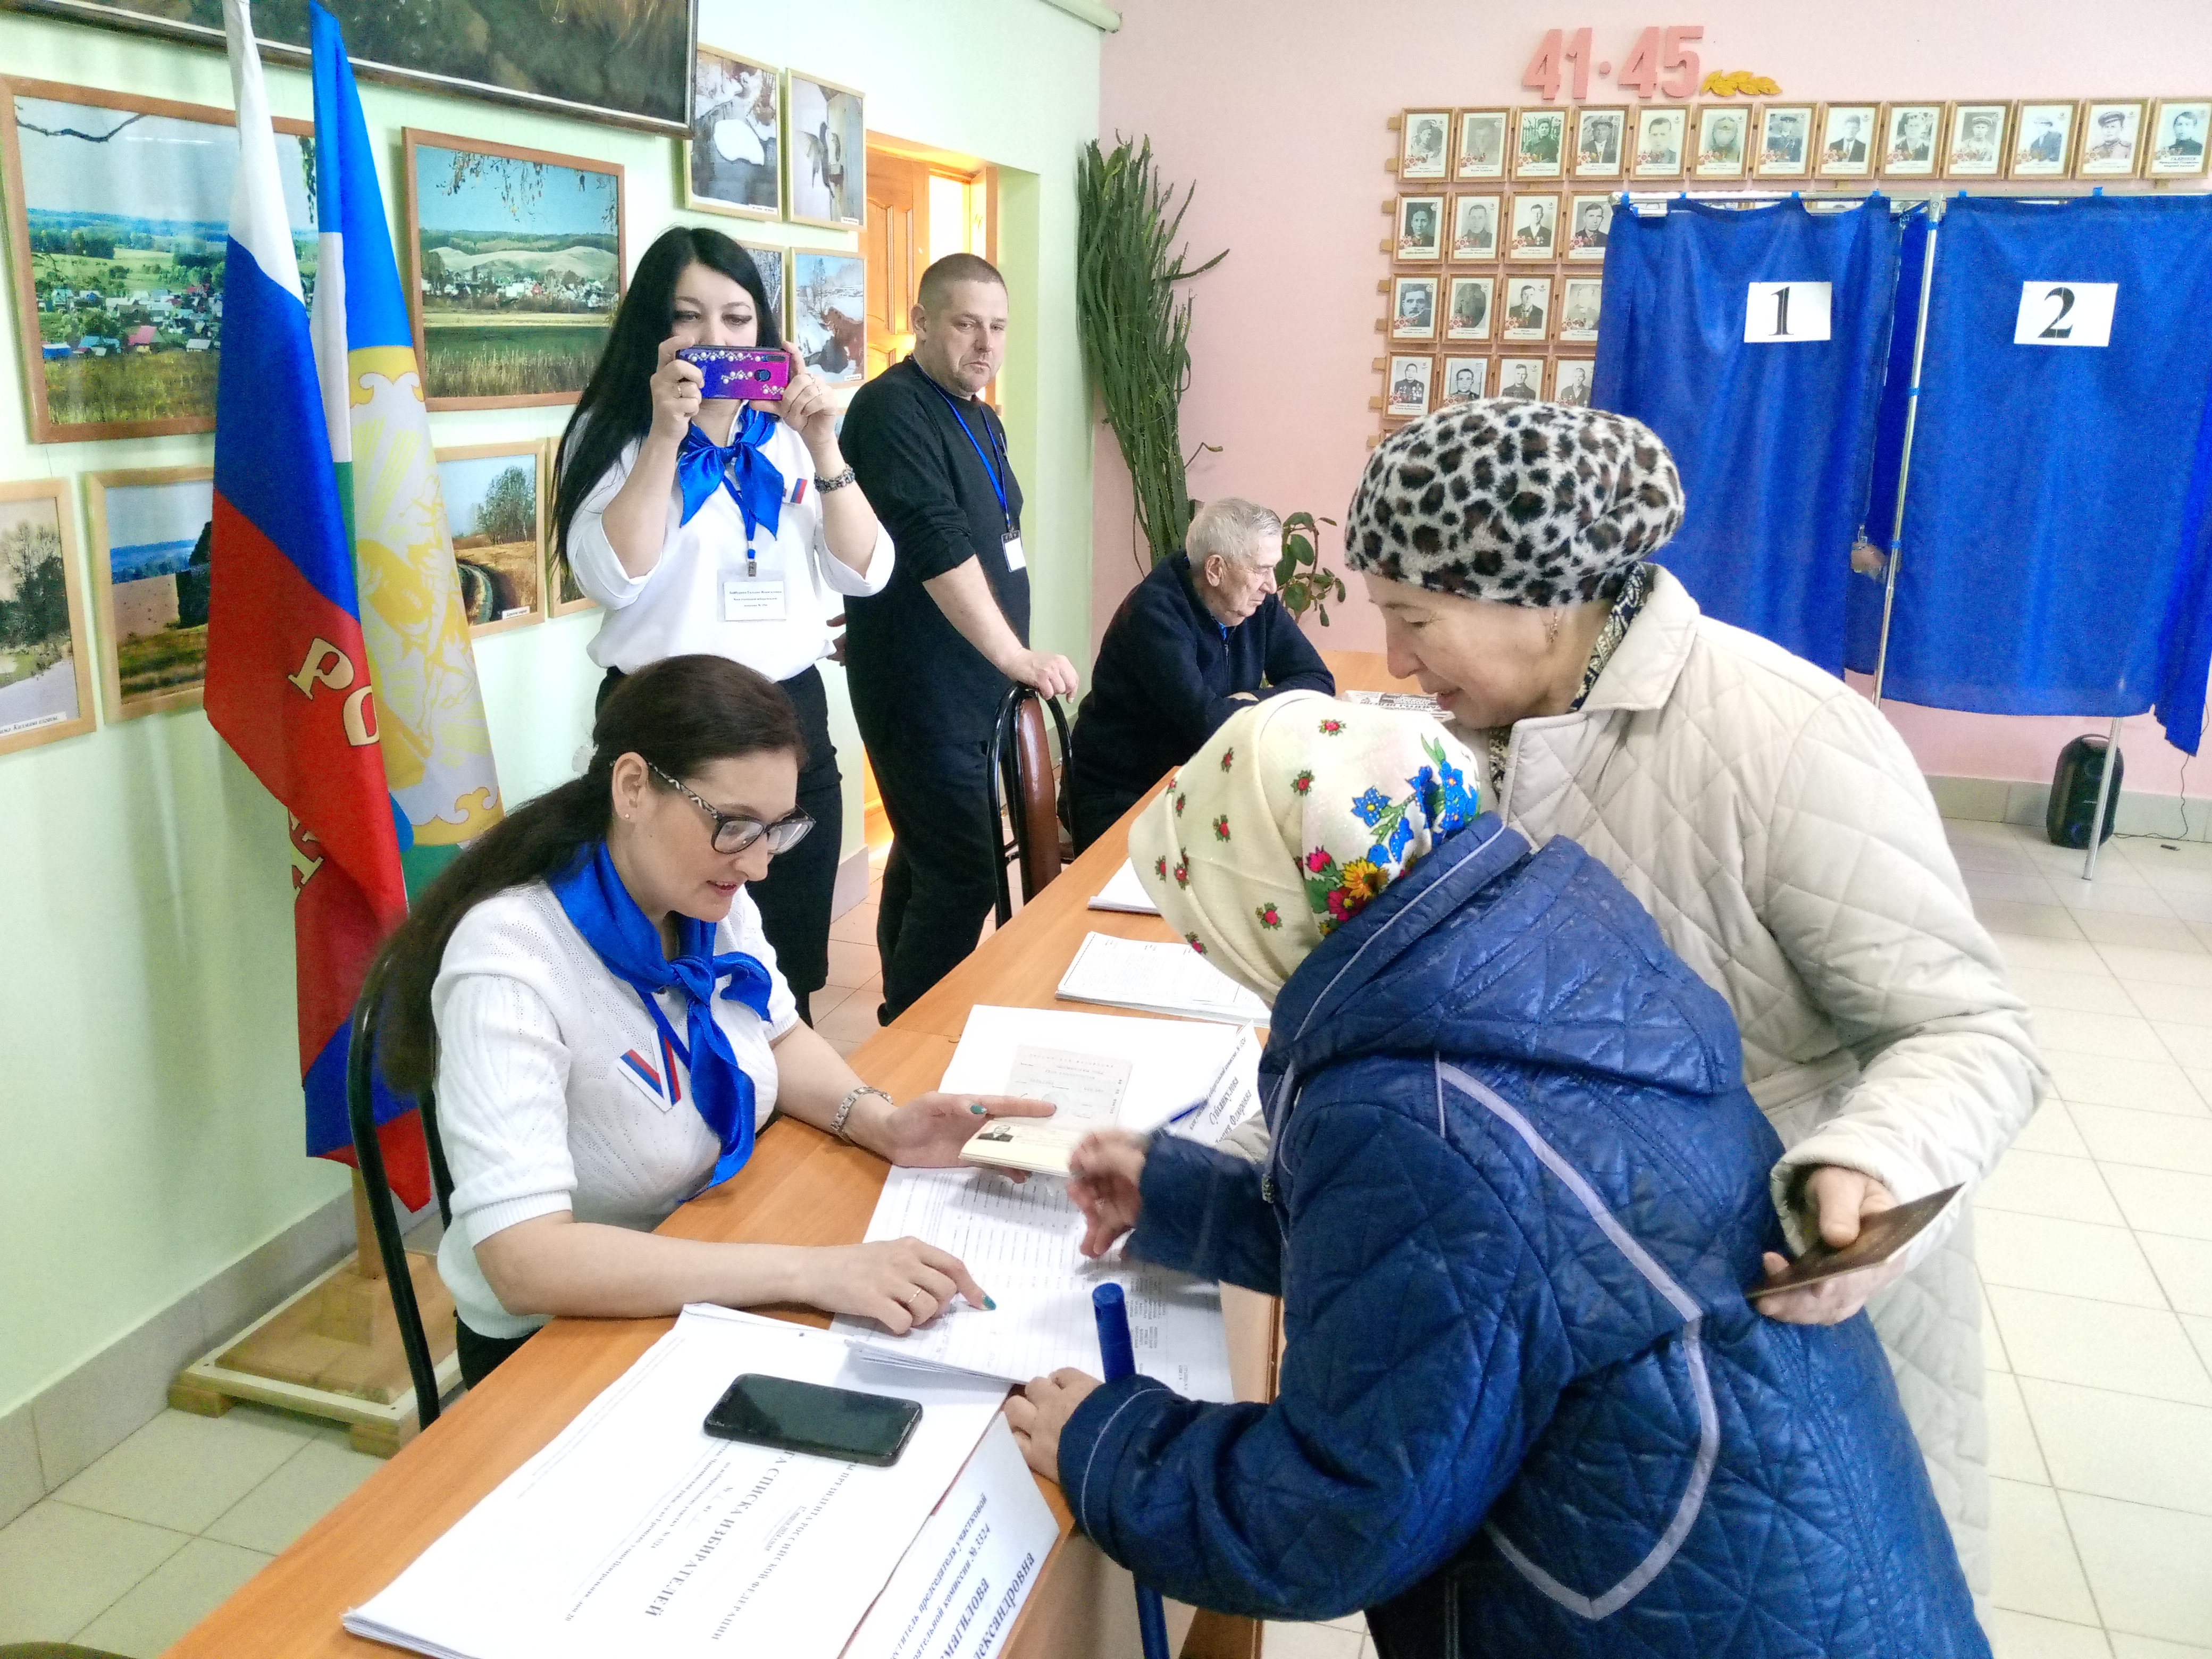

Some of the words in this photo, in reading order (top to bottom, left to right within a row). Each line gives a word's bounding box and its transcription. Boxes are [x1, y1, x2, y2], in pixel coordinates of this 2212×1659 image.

[1769, 286, 1794, 336] 1
[2038, 287, 2075, 338] 2
[729, 1469, 780, 1515] СПИСКА
[644, 1519, 735, 1616] ИЗБИРАТЕЛЕЙ
[757, 1522, 808, 1578] РОССИЙСКОЙ
[918, 1546, 958, 1614] председателя
[956, 1492, 988, 1549] участковой
[710, 1581, 760, 1640] ФЕДЕРАЦИИ
[912, 1606, 945, 1659] рательной
[943, 1559, 973, 1608] комиссии
[975, 1522, 991, 1549] 3324
[940, 1576, 991, 1659] магилова
[972, 1551, 1037, 1659] лександровна
